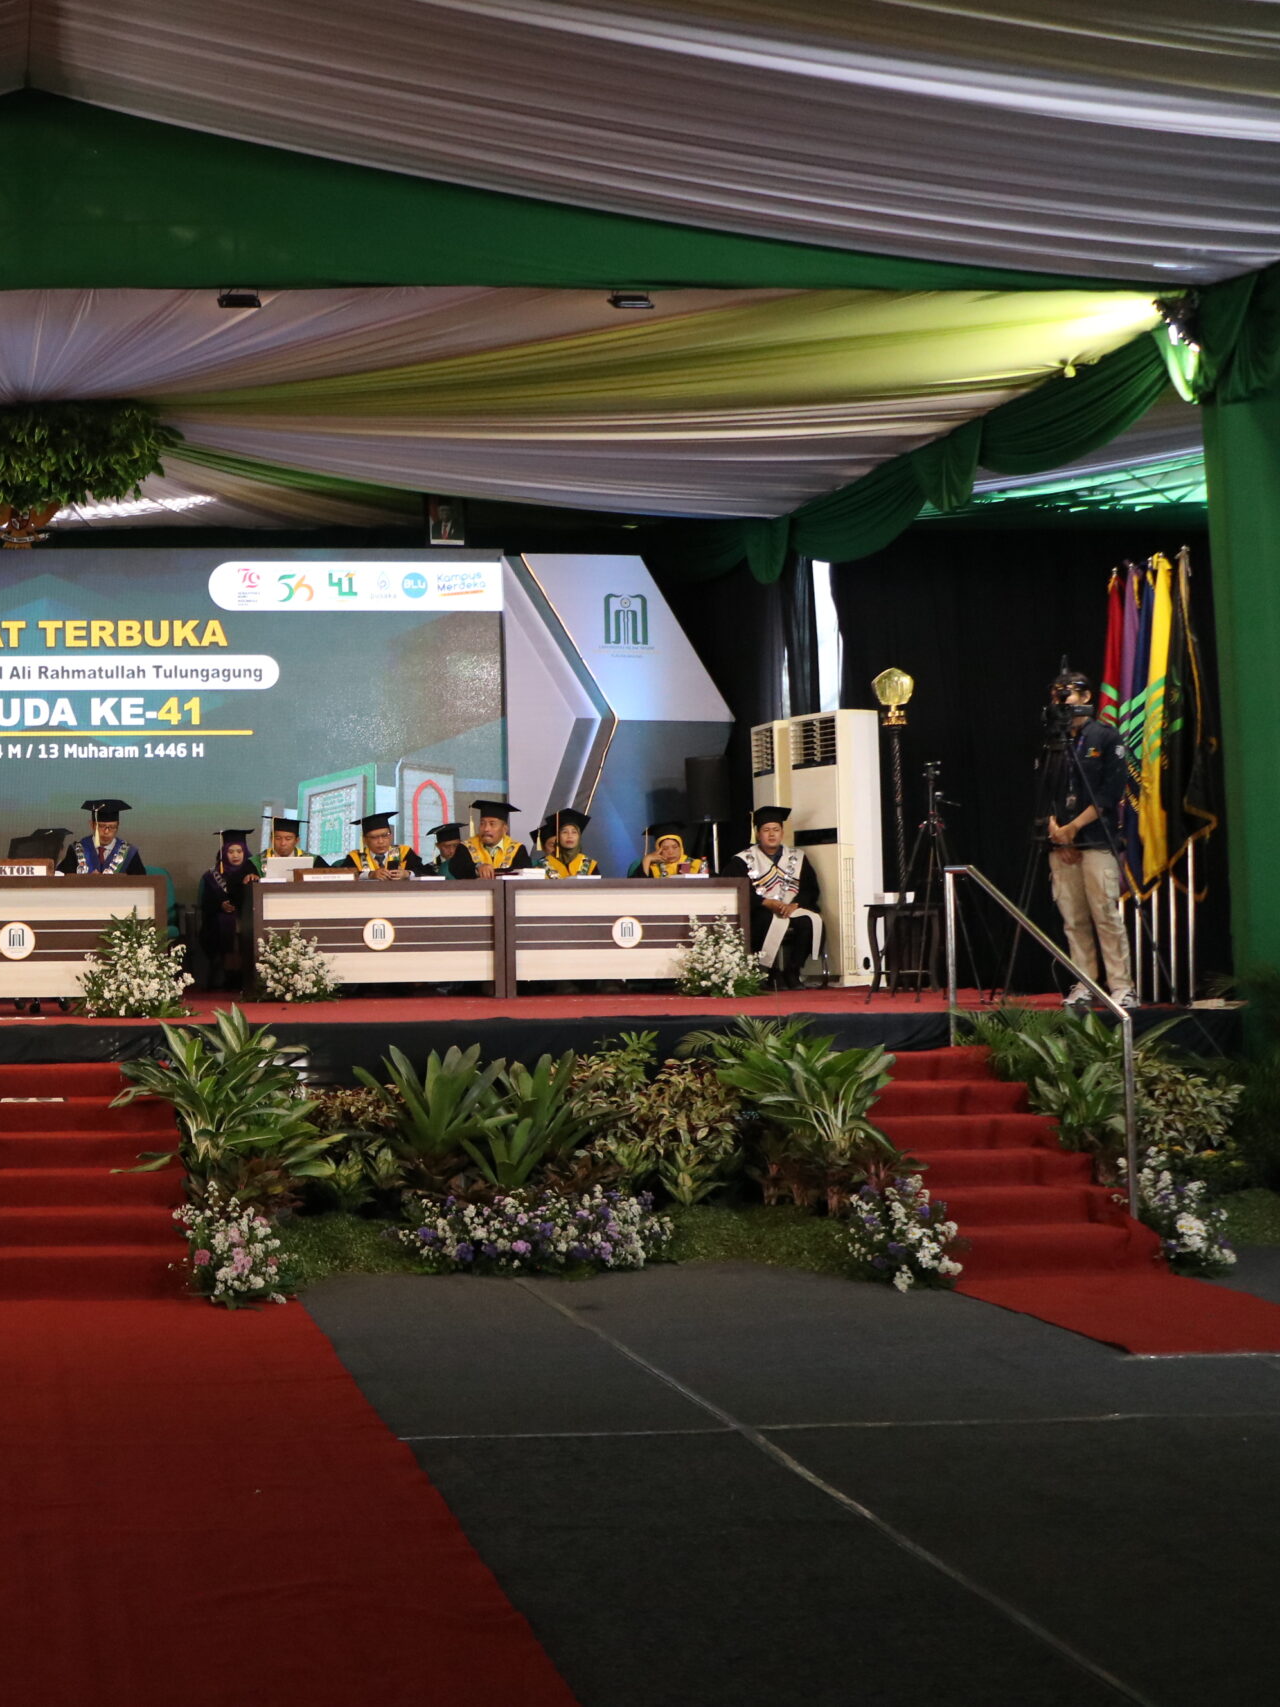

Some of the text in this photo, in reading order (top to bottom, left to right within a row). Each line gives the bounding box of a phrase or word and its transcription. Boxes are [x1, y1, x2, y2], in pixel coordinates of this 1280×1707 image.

[277, 573, 315, 602] 56
[403, 579, 426, 589] BLU
[436, 571, 482, 586] Kampus
[436, 580, 487, 592] Merdeka
[38, 619, 229, 648] TERBUKA
[9, 666, 32, 680] Ali
[38, 665, 146, 680] Rahmatullah
[152, 665, 263, 683] Tulungagung
[91, 696, 202, 726] KE-41
[7, 743, 22, 759] M
[25, 743, 34, 760] /
[38, 743, 59, 759] 13
[63, 742, 140, 759] Muharam
[144, 742, 188, 758] 1446
[191, 742, 205, 758] H
